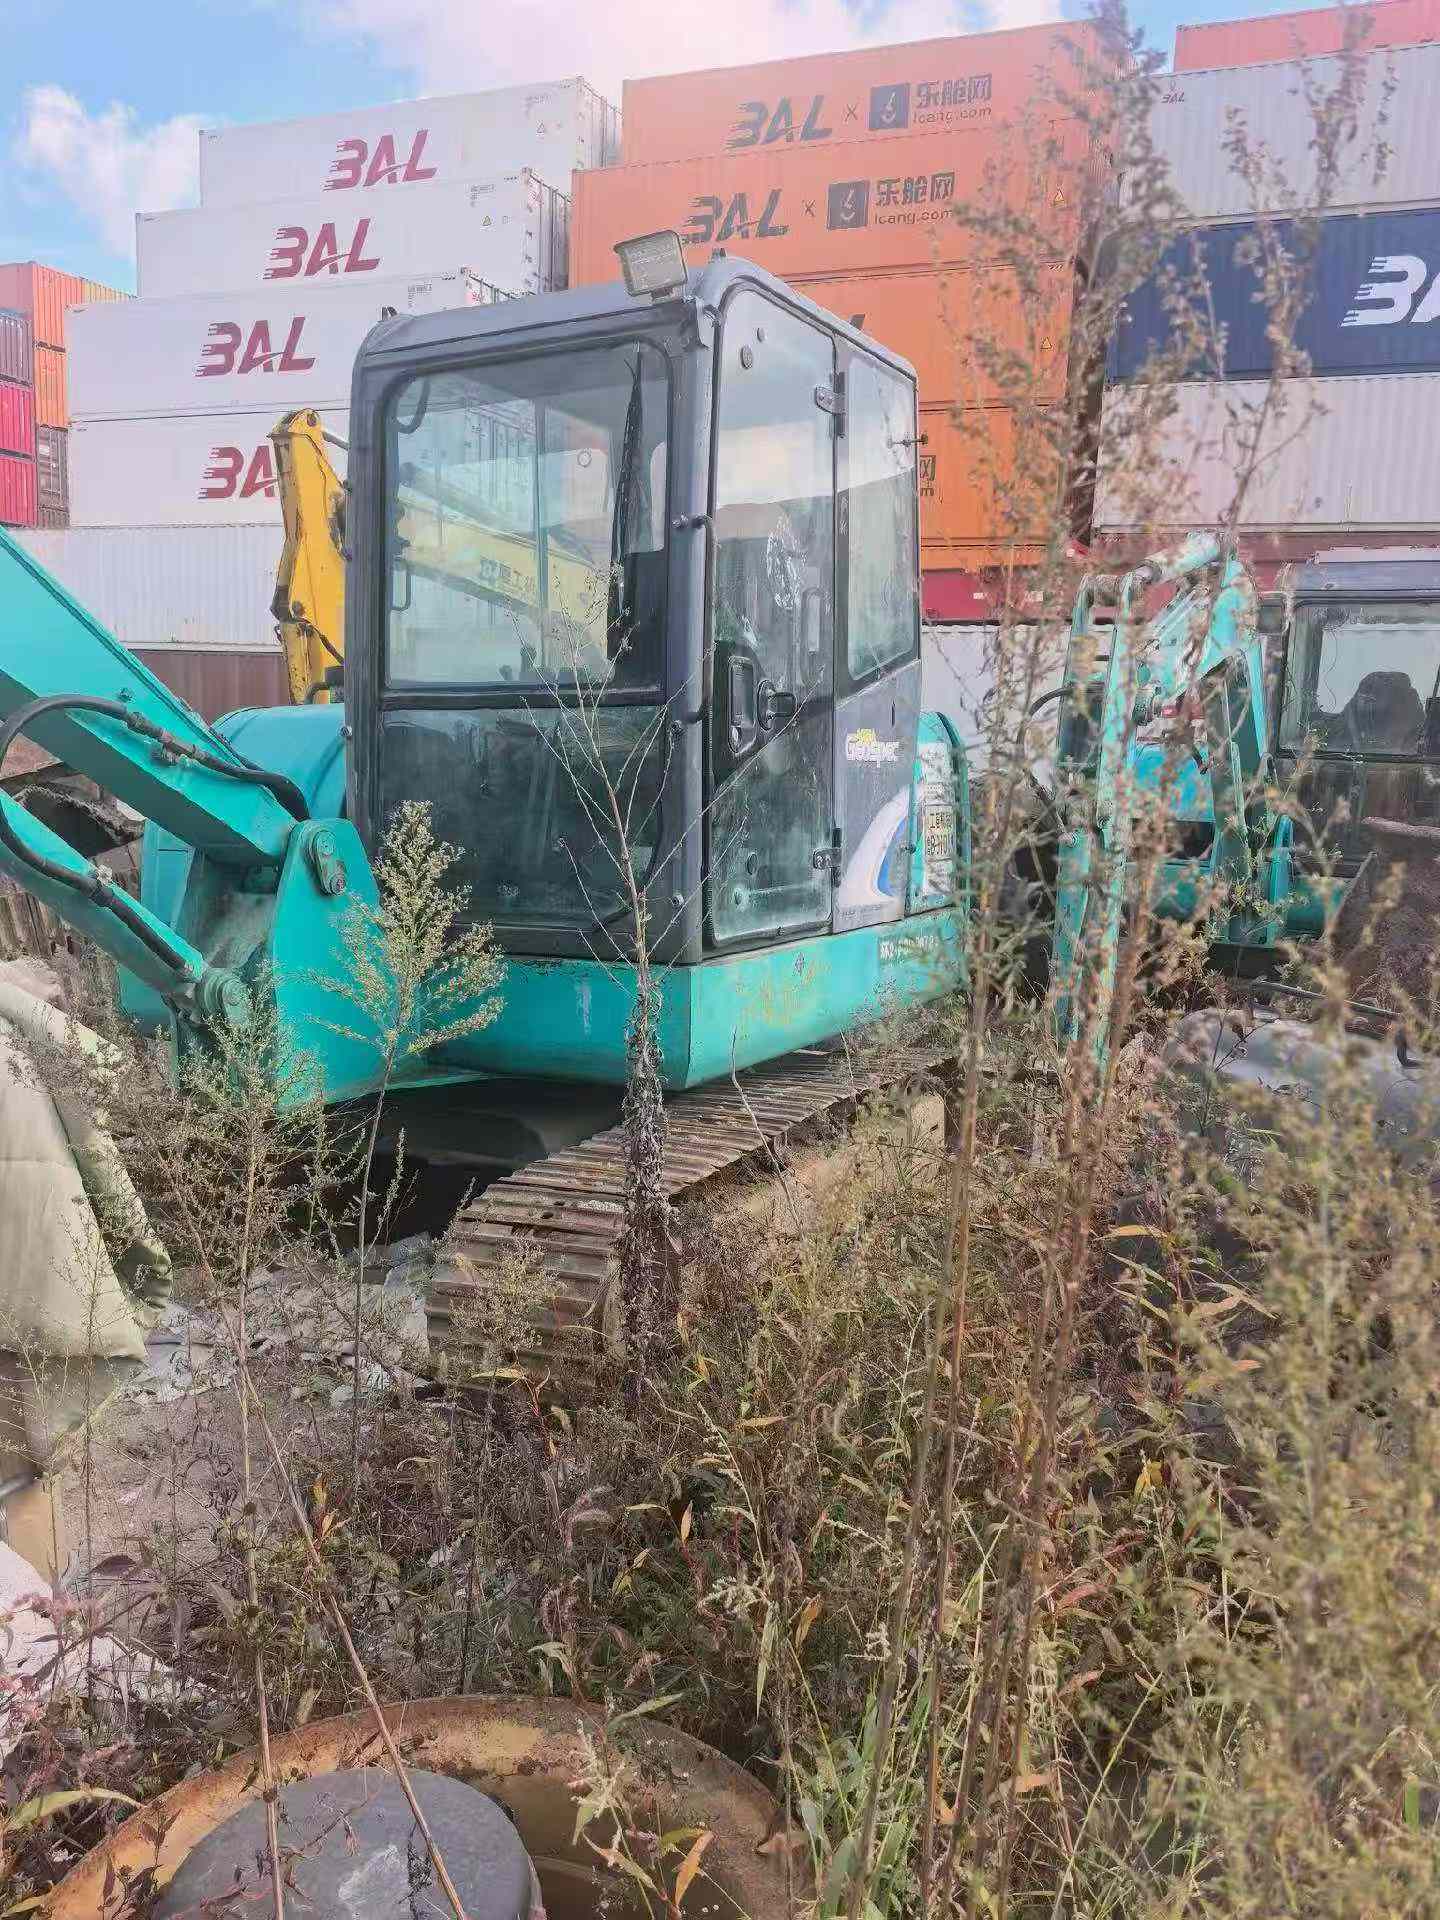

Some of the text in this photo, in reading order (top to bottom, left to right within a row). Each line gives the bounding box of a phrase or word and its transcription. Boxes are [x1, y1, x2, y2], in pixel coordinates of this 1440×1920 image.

[722, 94, 832, 151] BAL
[323, 129, 437, 191] BAL
[681, 188, 791, 245] BAL
[876, 172, 955, 206] 乐舱网
[263, 218, 380, 279] BAL
[195, 316, 316, 377] BAL
[198, 445, 278, 499] BA
